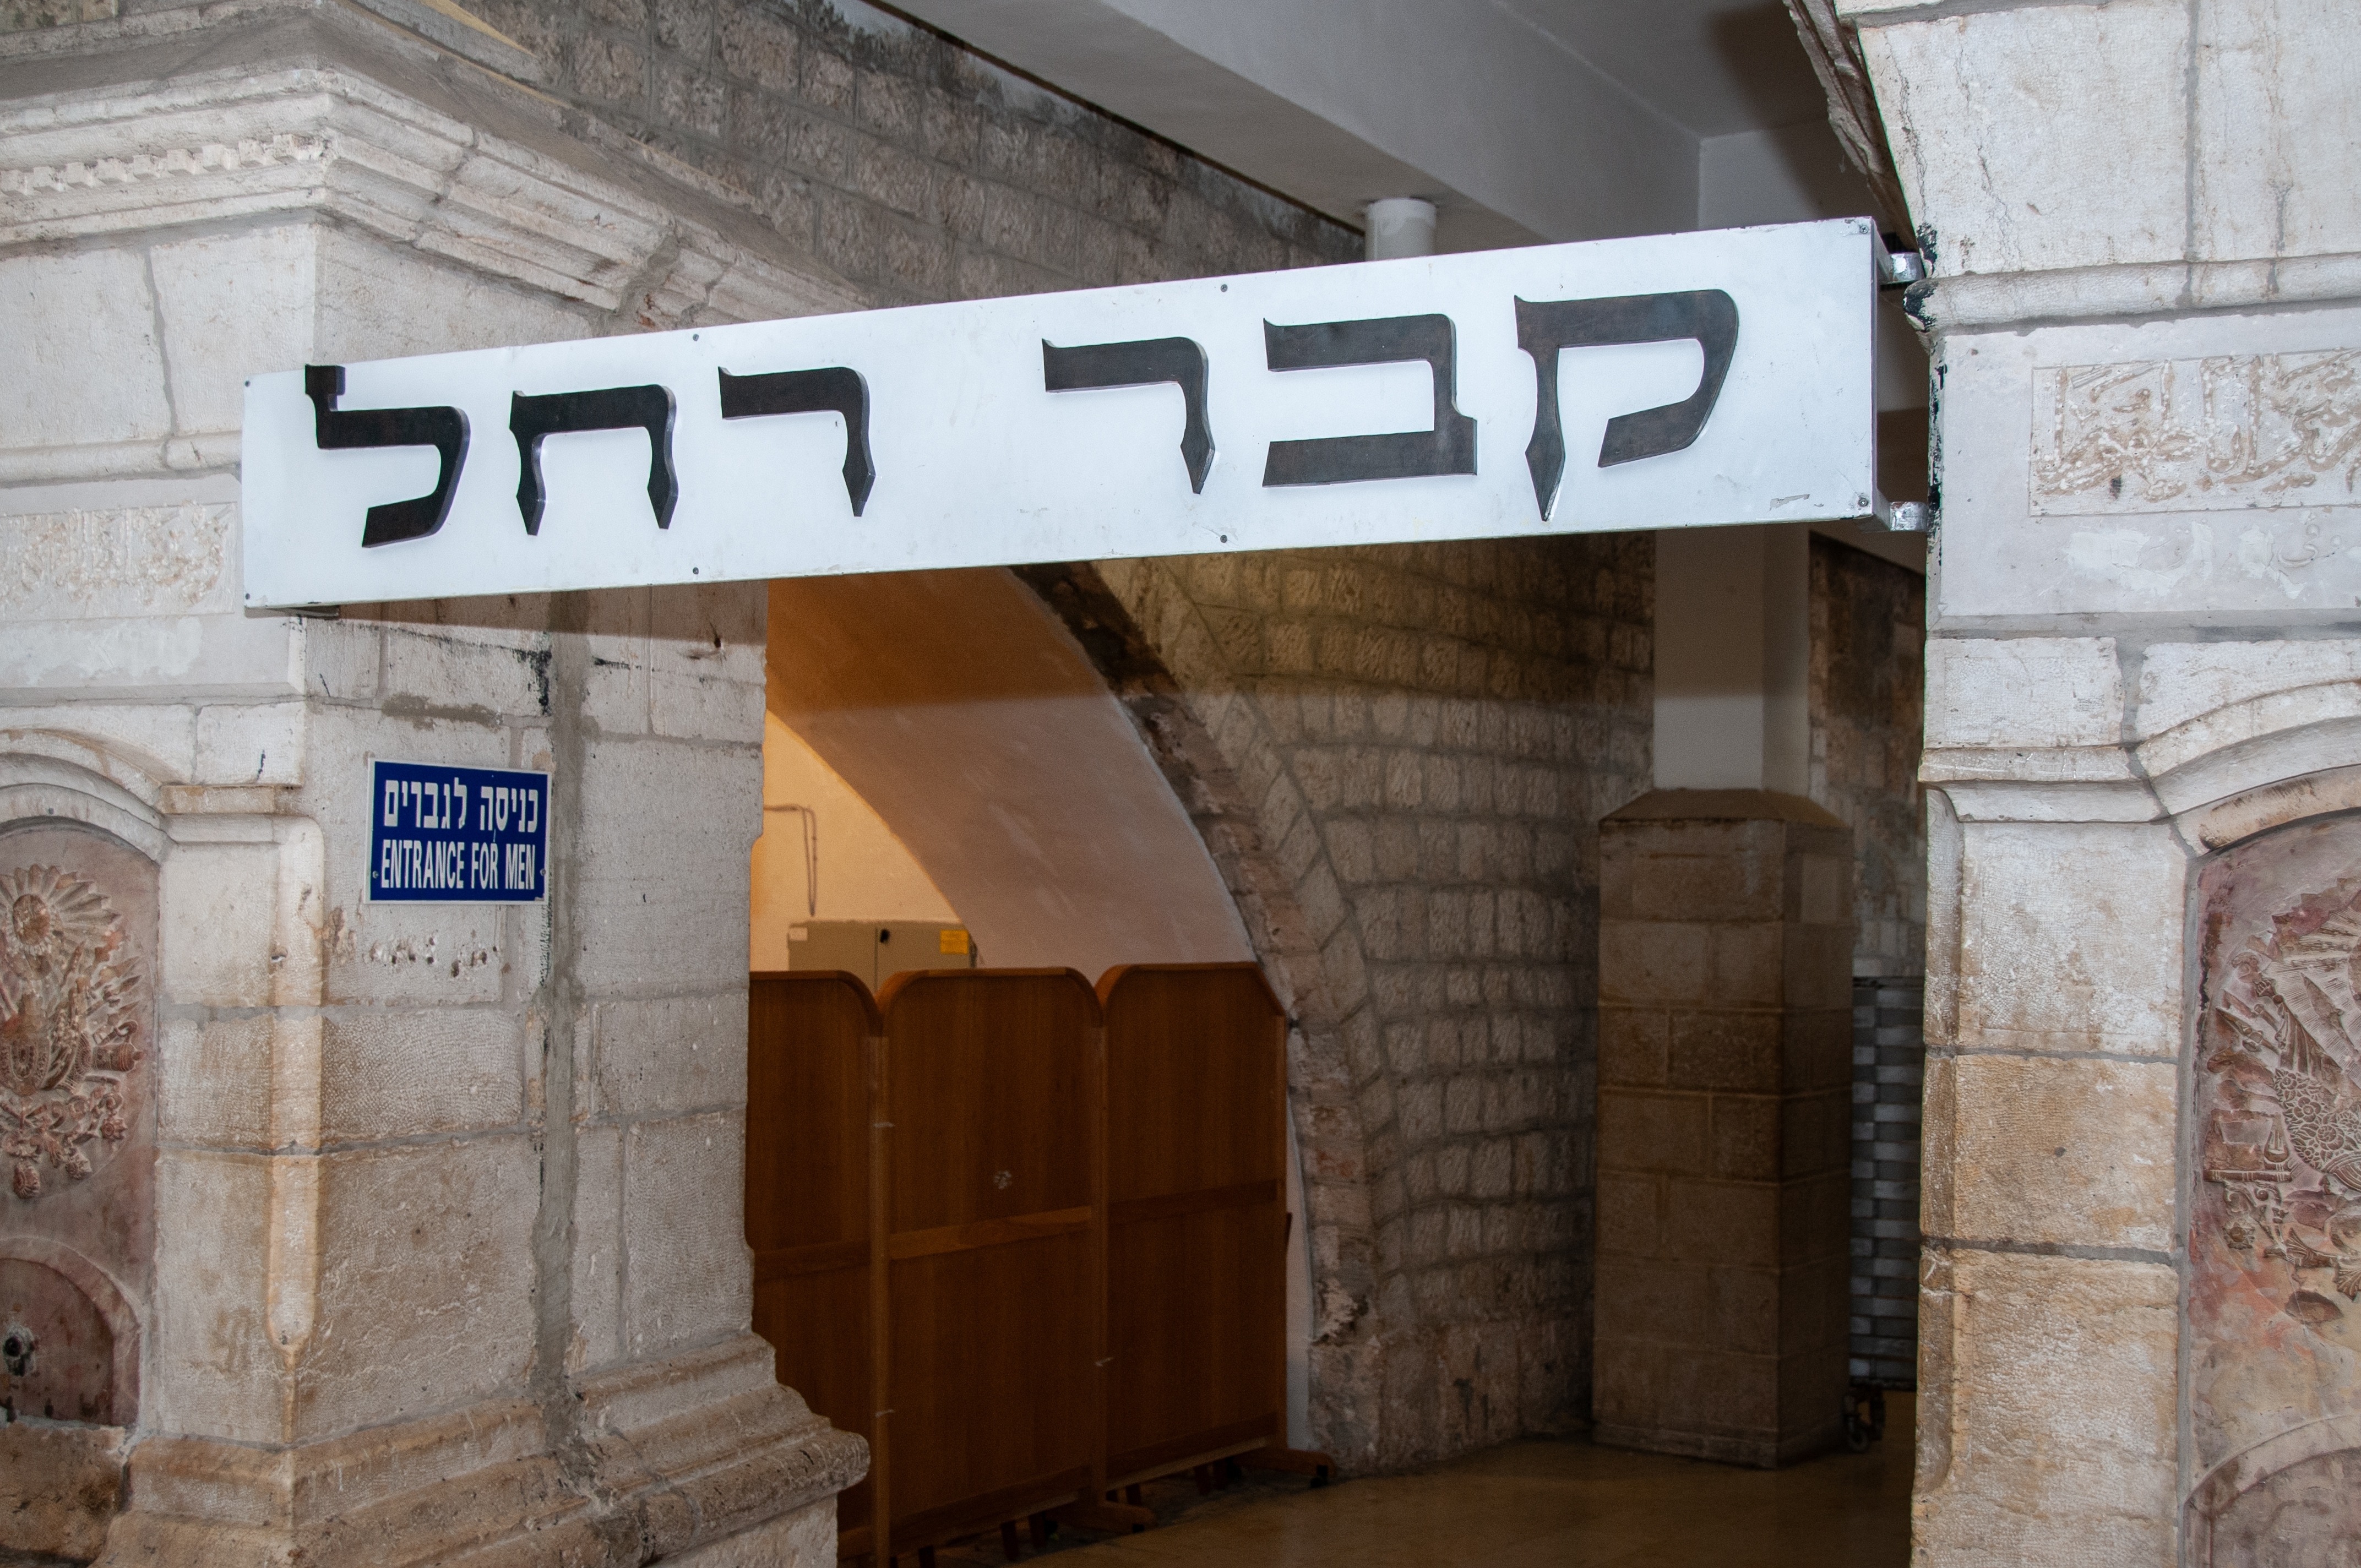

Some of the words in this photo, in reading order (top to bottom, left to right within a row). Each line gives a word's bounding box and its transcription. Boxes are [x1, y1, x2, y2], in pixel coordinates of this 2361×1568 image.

[1042, 289, 1739, 520] קבר
[304, 363, 877, 548] רחל
[384, 777, 467, 829] לגברים
[480, 786, 538, 832] כניסה
[381, 839, 465, 889] ENTRANCE
[471, 842, 498, 889] FOR
[505, 843, 535, 890] MEN
